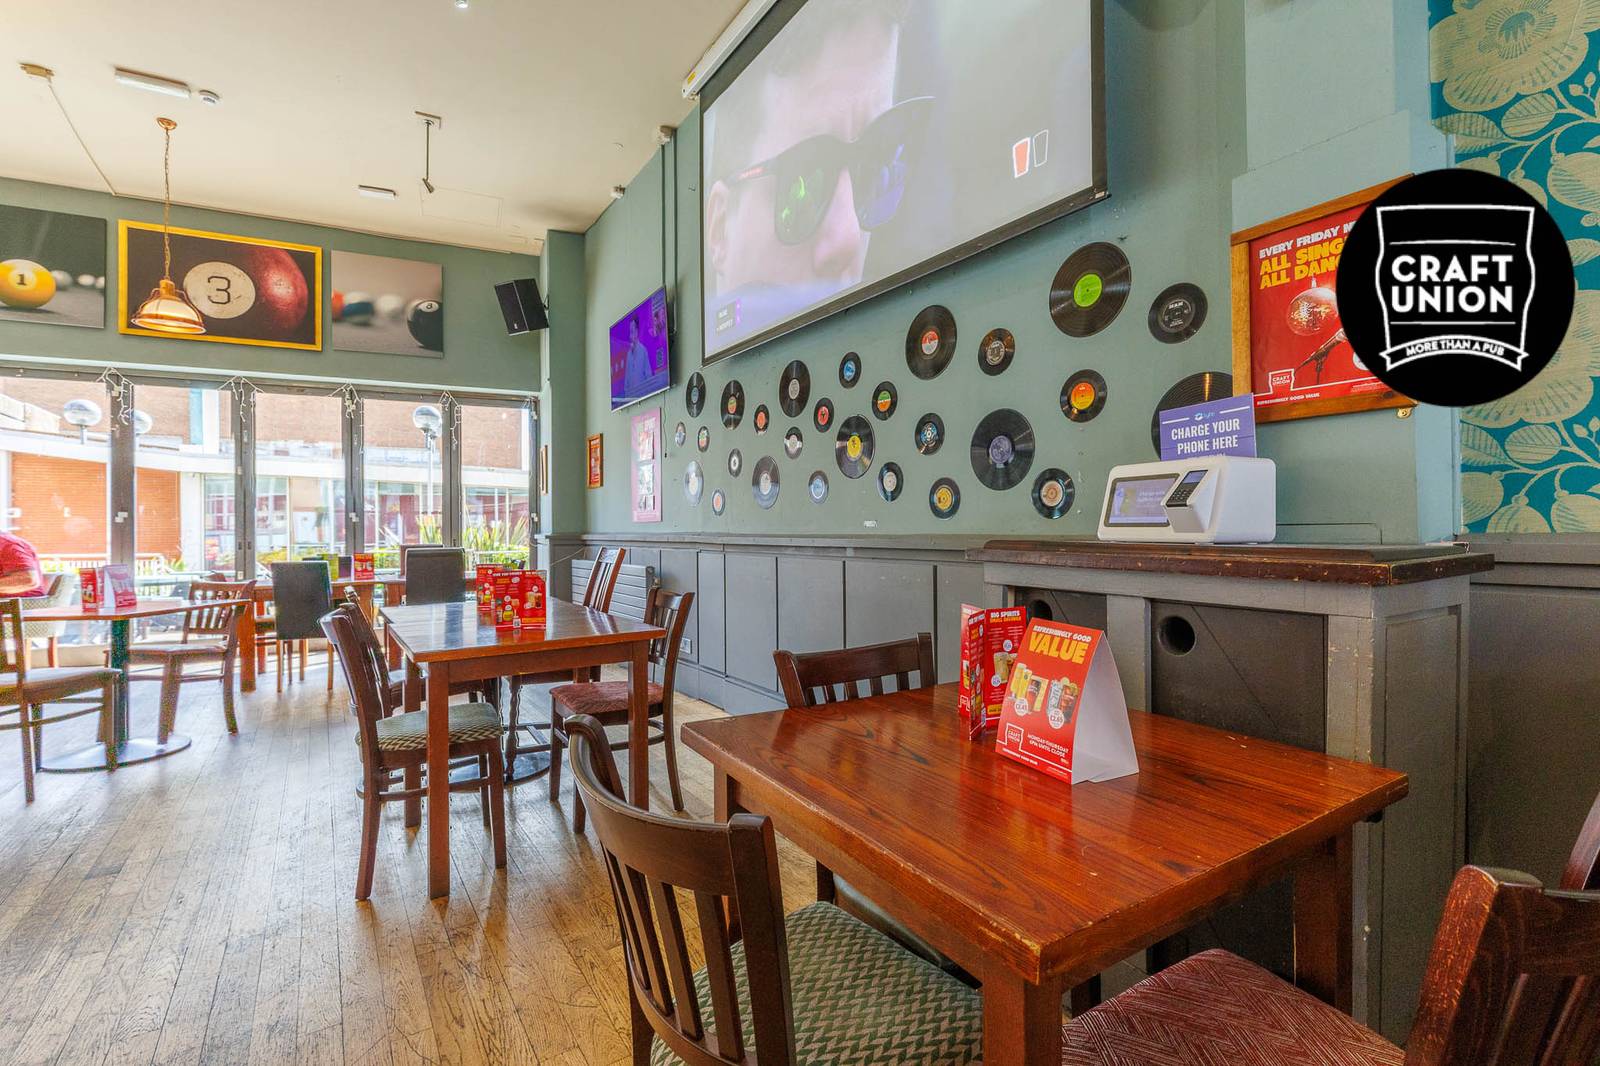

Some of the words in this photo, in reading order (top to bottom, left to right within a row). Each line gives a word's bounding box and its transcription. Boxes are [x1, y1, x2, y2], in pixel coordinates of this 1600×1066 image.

[1259, 240, 1294, 259] EVERY
[1296, 225, 1341, 247] FRIDAY
[1260, 254, 1291, 275] ALL
[16, 273, 28, 286] 1
[1260, 270, 1291, 290] ALL
[208, 275, 231, 306] 3
[1171, 423, 1210, 440] CHARGE
[1212, 418, 1241, 434] YOUR
[1177, 439, 1210, 455] PHONE
[1212, 435, 1239, 450] HERE
[1072, 632, 1093, 642] GOOD
[1029, 632, 1089, 665] VALUE
